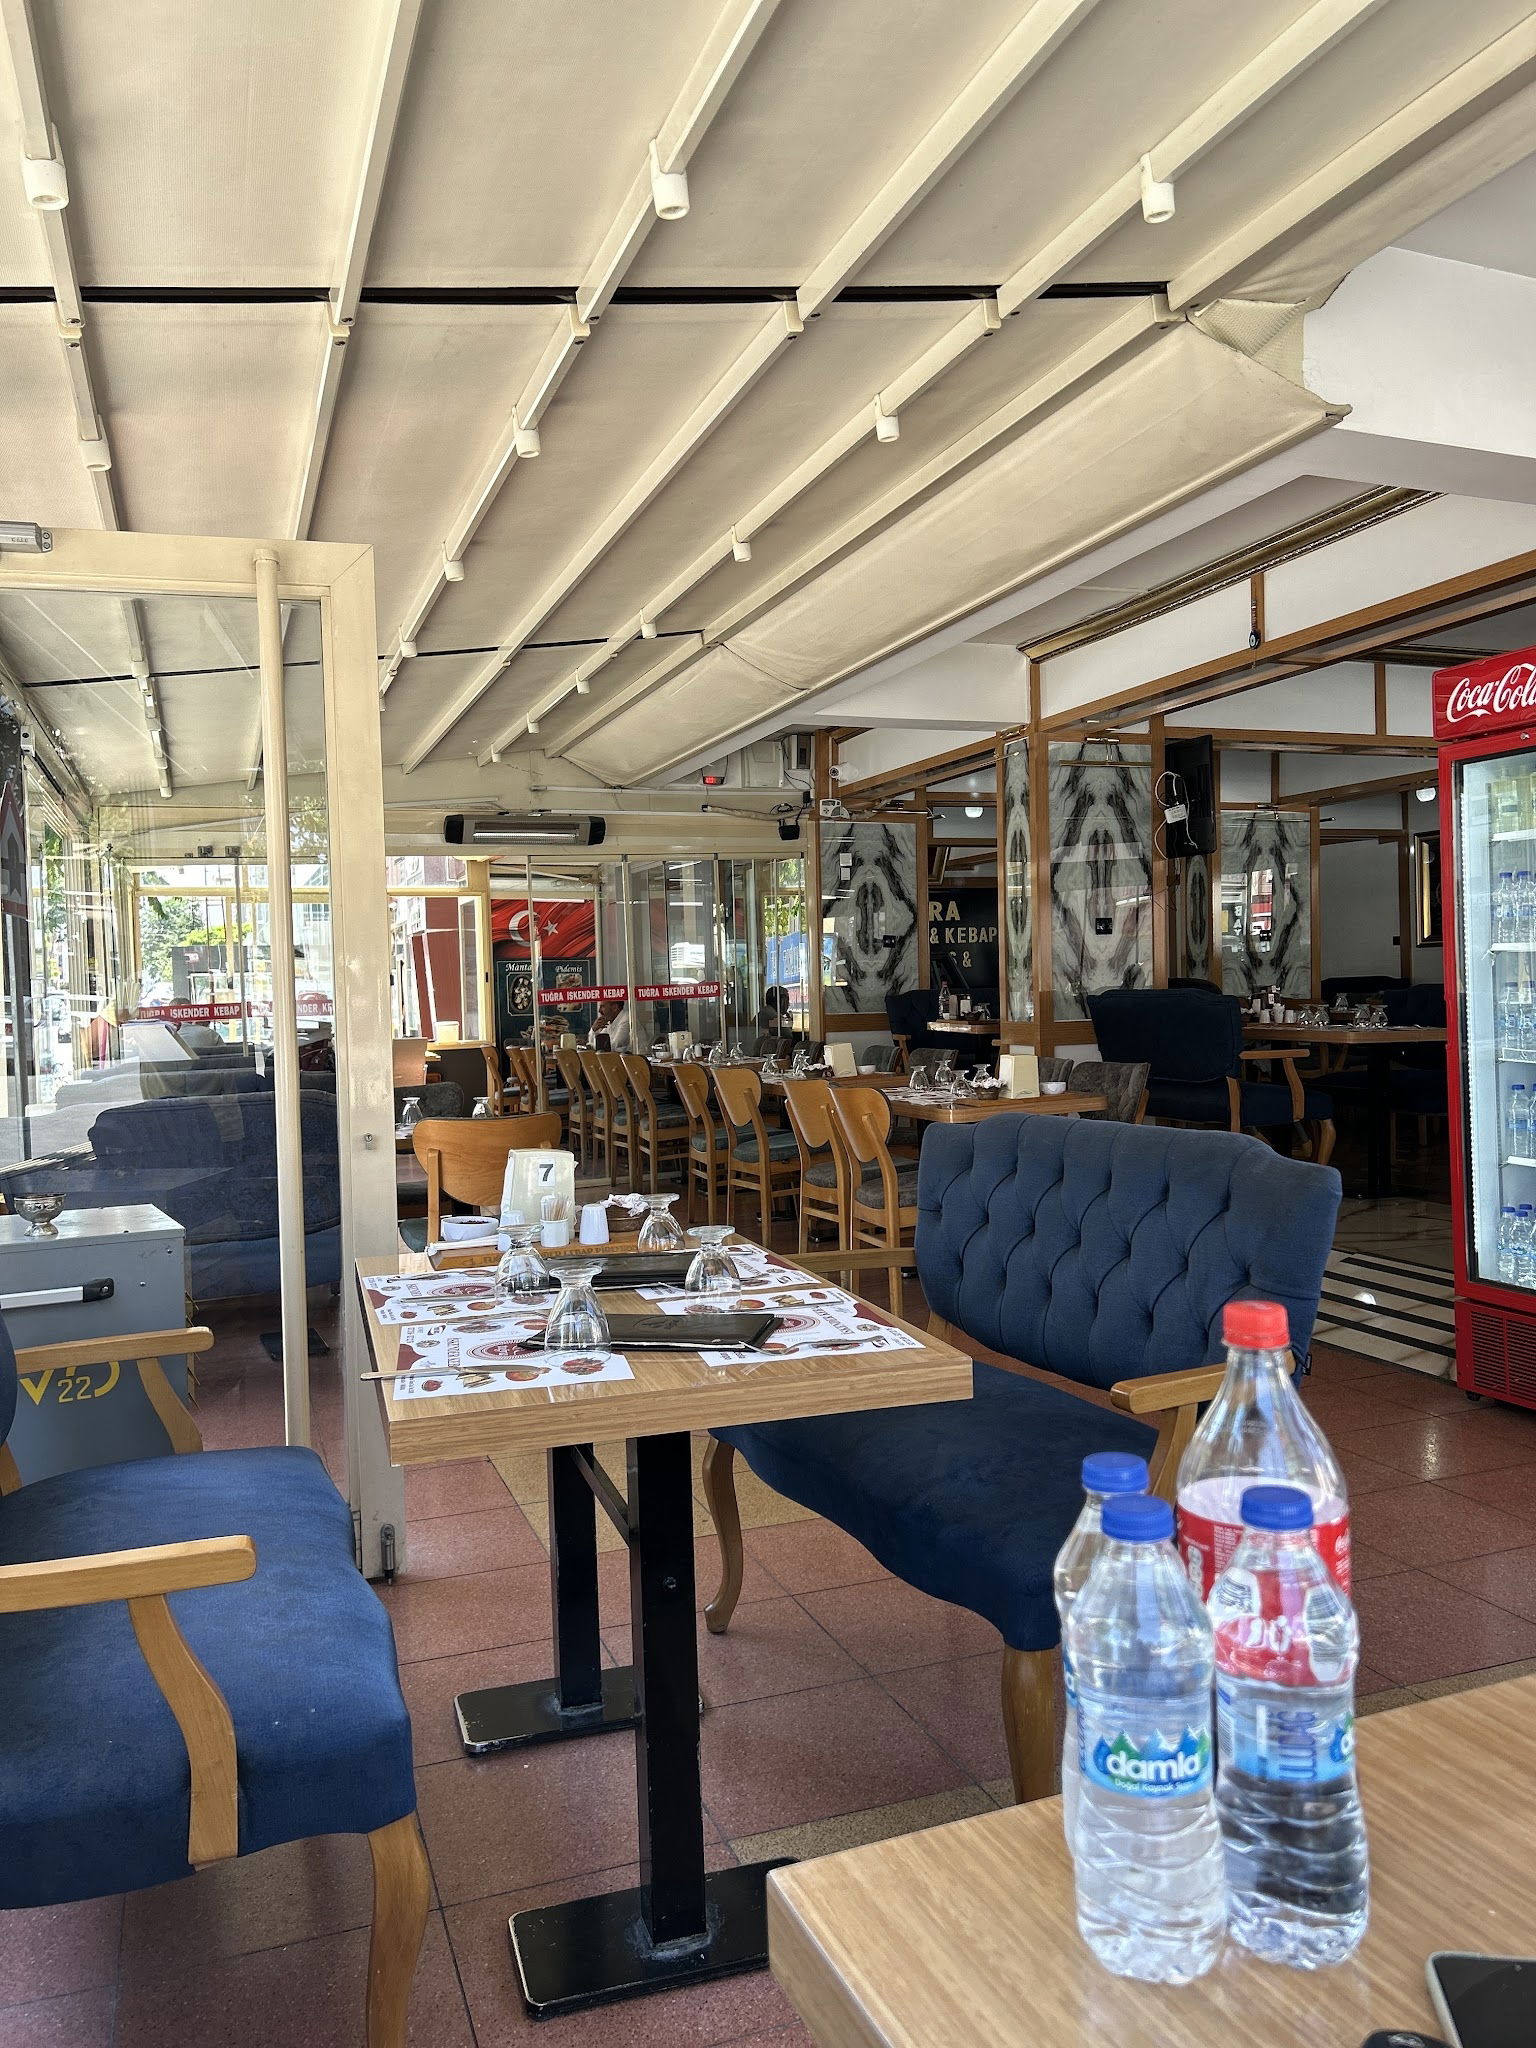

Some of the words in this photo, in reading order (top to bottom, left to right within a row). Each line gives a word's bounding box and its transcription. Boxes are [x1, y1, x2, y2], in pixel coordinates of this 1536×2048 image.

[929, 901, 960, 921] RA
[945, 927, 998, 944] KEBAP
[505, 962, 532, 972] Manta
[603, 988, 625, 999] KEBAP
[697, 984, 719, 995] KEBAP
[213, 1005, 240, 1017] KEBAP
[541, 1163, 554, 1182] 7
[58, 1376, 92, 1403] 22
[1106, 1750, 1201, 1781] damla
